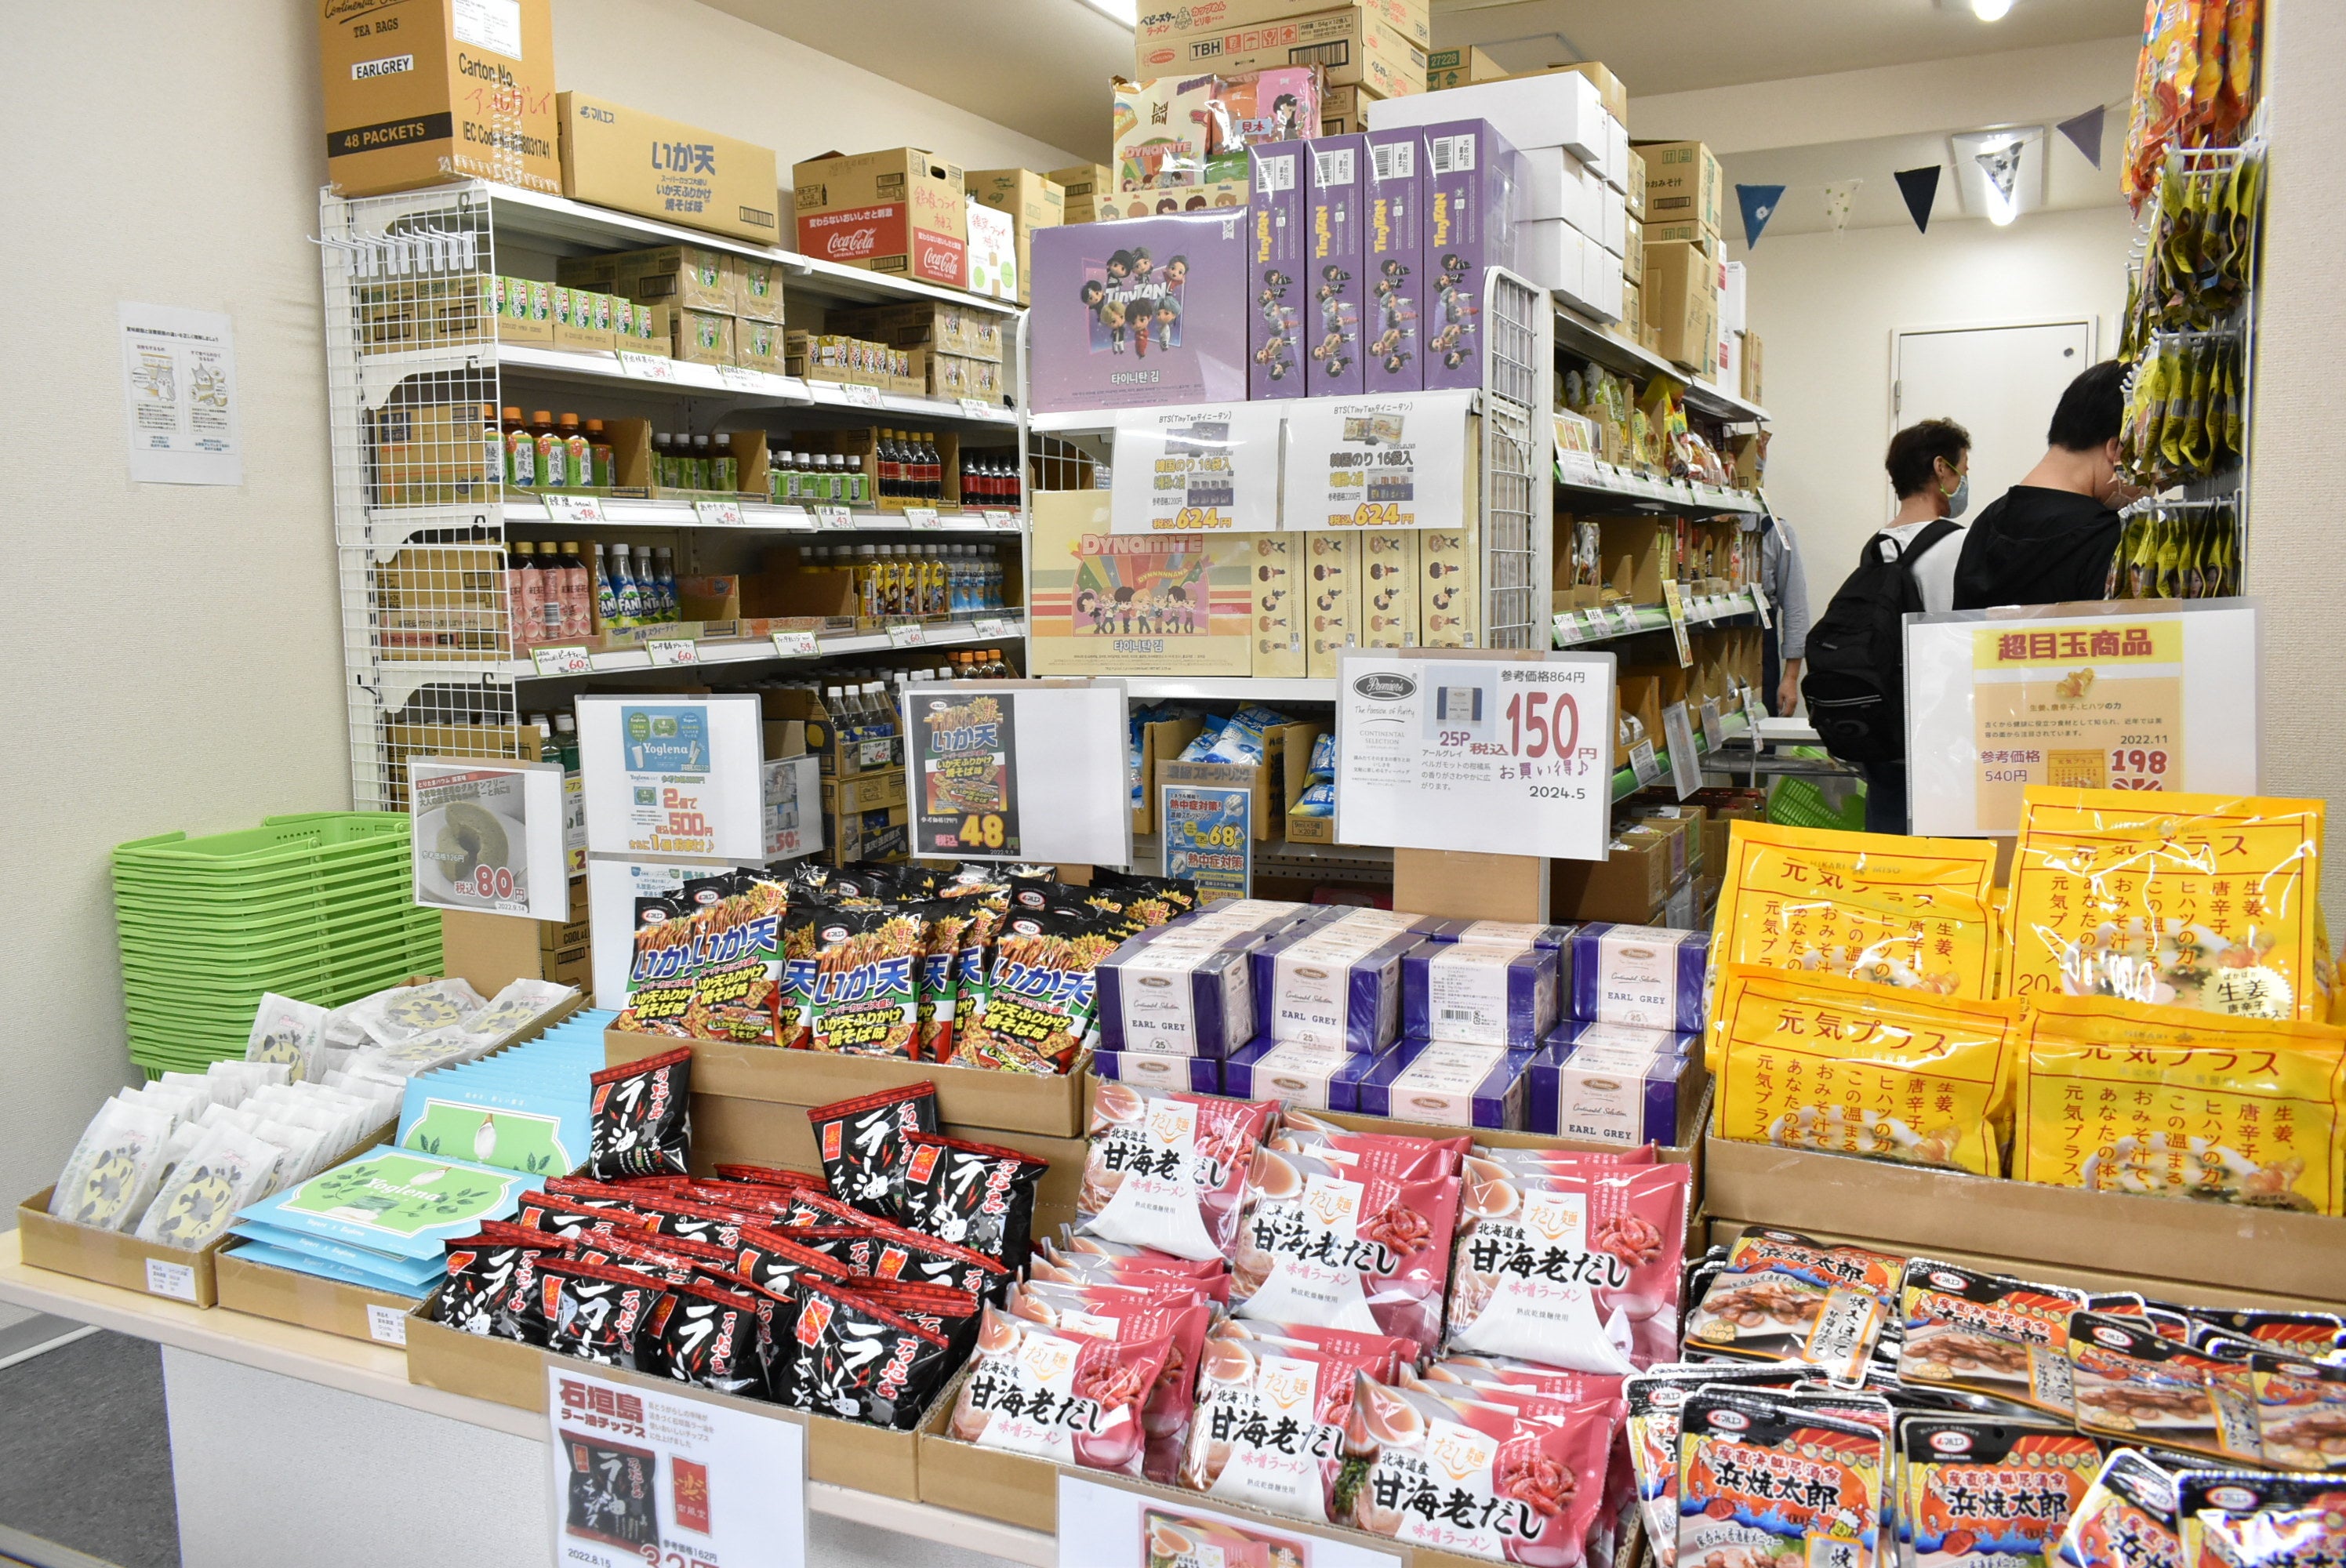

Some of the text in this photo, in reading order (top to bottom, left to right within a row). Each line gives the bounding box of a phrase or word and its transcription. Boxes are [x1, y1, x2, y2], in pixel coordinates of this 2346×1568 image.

[1192, 2, 1226, 14] カップめん
[354, 18, 398, 38] TEA BAGS
[1141, 13, 1175, 26] ベビースター
[1147, 25, 1170, 35] ラーメン
[1415, 24, 1428, 38] TBH
[1193, 41, 1220, 56] TBH
[357, 58, 409, 78] EARLGREY
[1431, 53, 1456, 65] 27228
[591, 108, 614, 123] マルエス
[345, 123, 425, 147] 48 PACKETS
[1242, 122, 1265, 133] 見本
[652, 142, 716, 175] いか天
[656, 185, 711, 199] いか天ふりかけ
[666, 198, 703, 212] 焼そば味
[809, 209, 893, 228] 変わらないおいしさと刺激
[1375, 199, 1387, 252] TinyTAN
[1434, 192, 1447, 247] TinyTAN
[828, 228, 877, 253] Coca-Cola
[1258, 210, 1269, 263] TinyTAN
[1316, 205, 1327, 258] TinyTAN
[924, 248, 958, 274] Coca-Cola
[1155, 459, 1195, 472] 韓国のり
[1330, 450, 1413, 467] 韓国のり 16袋入
[580, 509, 594, 518] 48
[1153, 507, 1232, 529] 税込624円
[1329, 503, 1414, 527] 税込624円
[1998, 628, 2152, 661] 超目玉商品
[569, 659, 584, 669] 60
[678, 650, 692, 661] 60
[1501, 670, 1585, 684] 参考価格864円
[932, 723, 997, 753] いか天
[1439, 731, 1470, 746] 25P
[2120, 735, 2168, 744] 2022.11
[643, 742, 688, 756] Yoglena
[1981, 750, 2040, 764] 参考価格
[937, 756, 993, 768] いか天ふりかけ
[2112, 750, 2167, 775] 198
[1422, 772, 1491, 782] の香りがさわやかに広
[1985, 769, 2028, 782] 540円
[1529, 786, 1585, 799] 2024.5
[1188, 852, 1244, 871] 熱中症対策
[455, 864, 525, 901] 税込80円
[692, 915, 778, 967] いか天
[812, 955, 913, 1007] いか天
[989, 958, 1096, 1009] いか天
[1607, 992, 1665, 1005] EARL GREY
[2217, 979, 2269, 1004] 生姜
[1132, 1020, 1186, 1031] EARL GREY
[1281, 1011, 1337, 1025] EARL GREY
[1303, 1033, 1313, 1042] 25
[1776, 1008, 1948, 1056] 元気プラス
[1155, 1040, 1166, 1049] 25
[1843, 1071, 1863, 1152] この温まる
[1111, 1127, 1147, 1143] 北海道産
[1569, 1124, 1632, 1140] EARL GREY
[2165, 1094, 2188, 1185] この温まる
[364, 1178, 441, 1201] Yoglena
[1131, 1178, 1188, 1198] 味噌ラーメン
[1478, 1223, 1526, 1240] 北海道産
[1252, 1218, 1397, 1274] 甘海老だし
[1469, 1239, 1628, 1288] 甘海老だし
[1759, 1247, 1867, 1283] 浜焼太郎
[1286, 1262, 1352, 1286] 味噌ラーメン
[1509, 1281, 1582, 1302] 味噌ラーメン
[979, 1360, 1020, 1380] 北海道産
[559, 1377, 643, 1423] 石垣島
[971, 1375, 1104, 1435] 甘海老だし
[561, 1407, 646, 1439] ラー油チップス
[998, 1421, 1063, 1446] 味噌ラーメン
[1211, 1406, 1345, 1461] 甘海老だし
[1241, 1454, 1309, 1475] 味噌ラーメン
[1382, 1452, 1429, 1475] 北海道産
[1715, 1460, 1842, 1513] 浜焼太郎
[1372, 1468, 1543, 1540] 甘海老だし
[1947, 1488, 2068, 1523] 浜焼太郎
[1412, 1524, 1491, 1552] 味噌ラーメン
[568, 1548, 612, 1568] 2022.8.15
